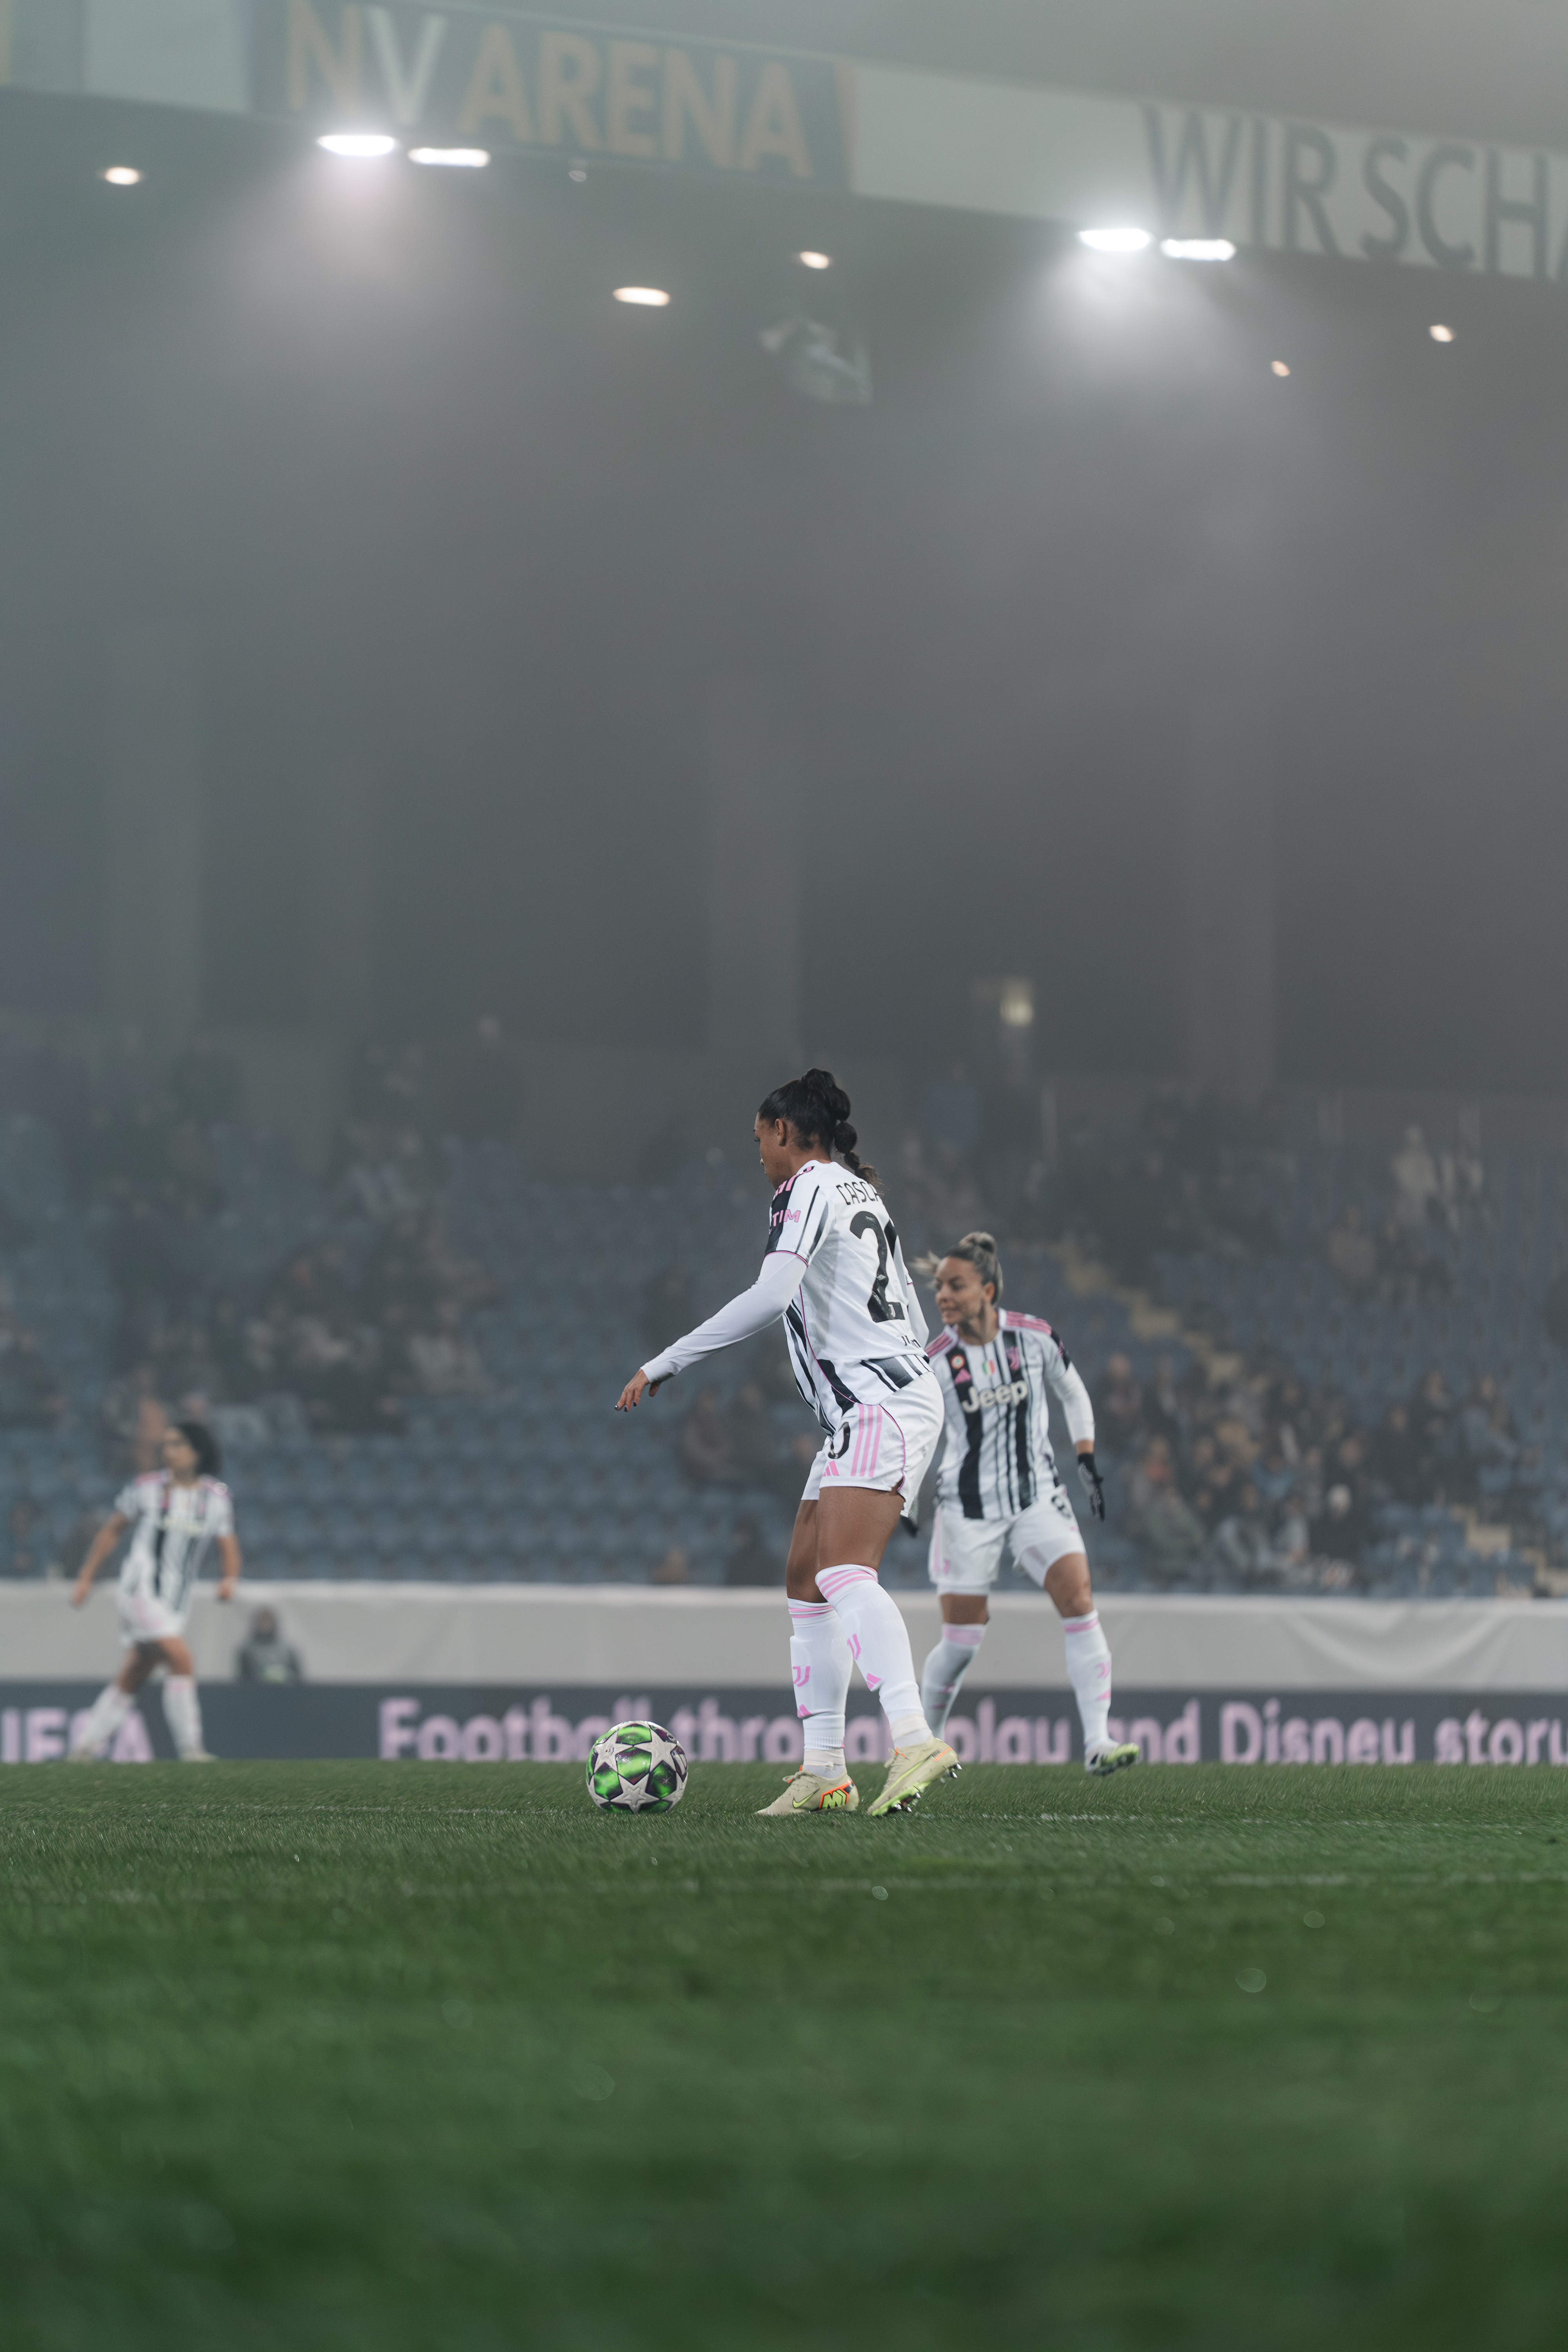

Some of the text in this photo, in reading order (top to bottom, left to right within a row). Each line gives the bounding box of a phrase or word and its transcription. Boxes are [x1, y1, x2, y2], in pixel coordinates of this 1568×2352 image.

[287, 0, 815, 180] NV ARENA
[1140, 101, 1568, 285] WIR SCH
[772, 1209, 801, 1227] TIM
[850, 1210, 905, 1323] 2
[962, 1379, 1028, 1413] Jeep
[1107, 1697, 1200, 1764] nd
[1220, 1698, 1415, 1764] Disney
